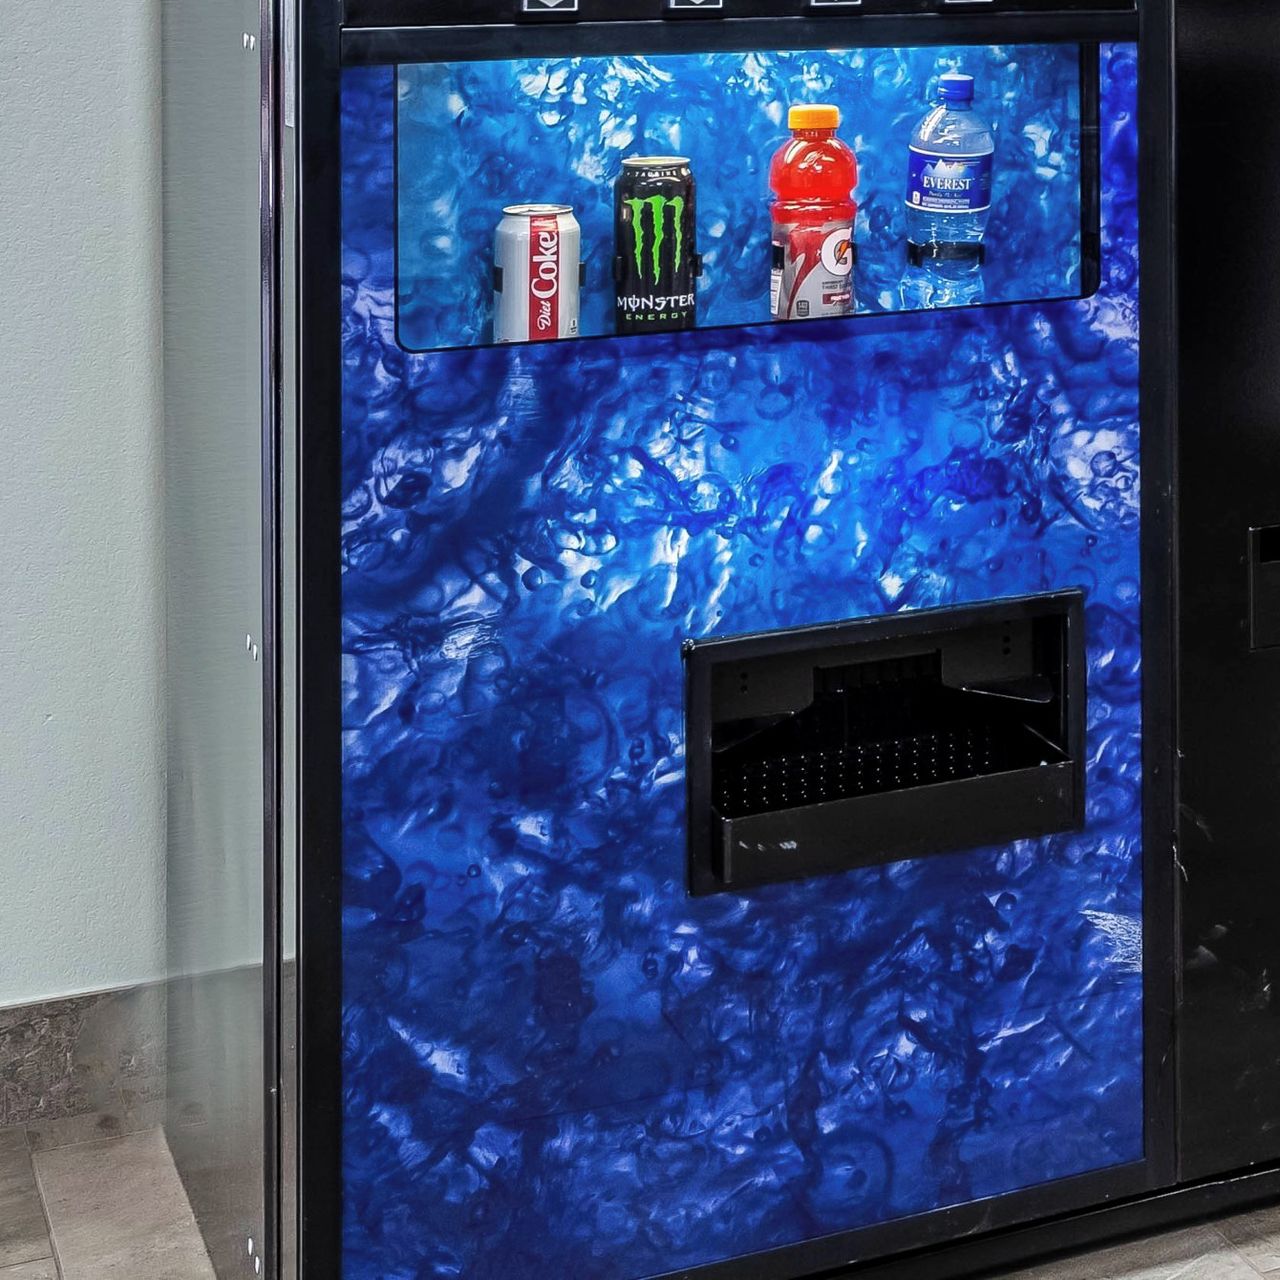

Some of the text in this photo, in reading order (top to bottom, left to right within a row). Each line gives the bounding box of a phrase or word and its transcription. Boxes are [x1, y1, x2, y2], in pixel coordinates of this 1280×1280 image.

[923, 176, 971, 190] EVEREST
[531, 231, 558, 331] Diet Coke
[617, 293, 695, 312] MONSTER
[626, 311, 688, 320] ENERGY
